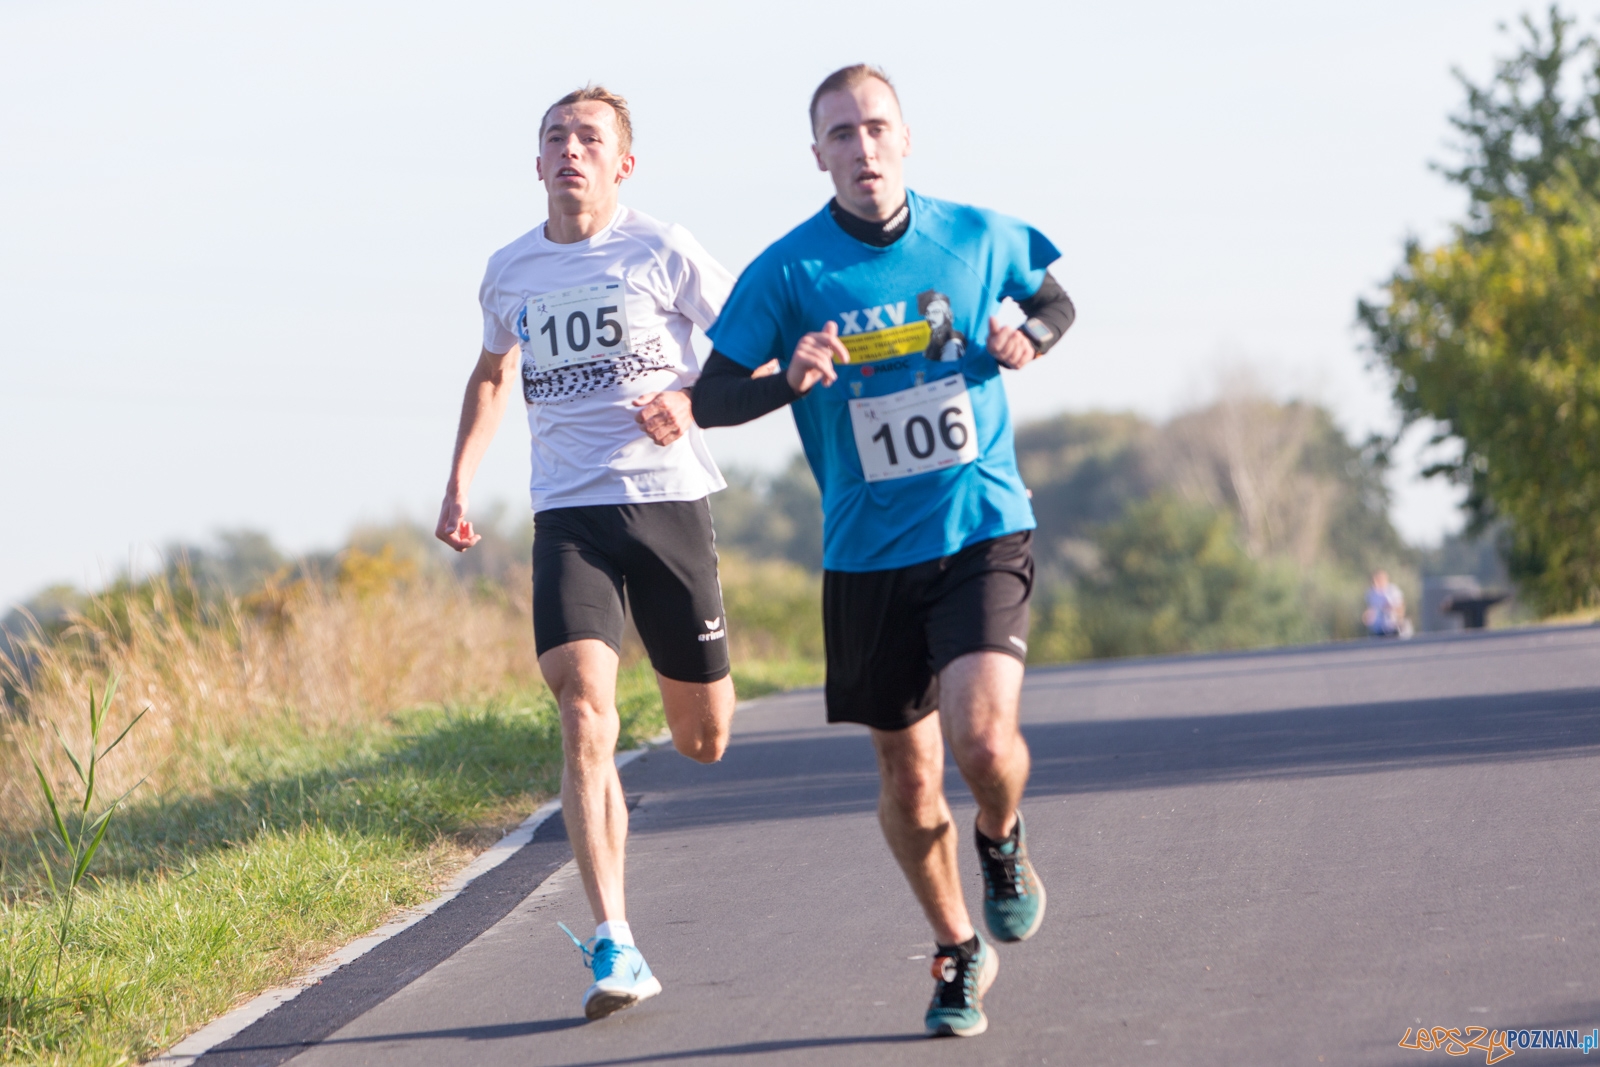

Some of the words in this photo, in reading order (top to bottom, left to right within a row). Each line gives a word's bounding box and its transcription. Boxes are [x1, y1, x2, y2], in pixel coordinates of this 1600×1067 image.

[540, 305, 623, 357] 105
[839, 301, 907, 335] XXV
[874, 359, 909, 374] PAROC
[872, 406, 968, 466] 106
